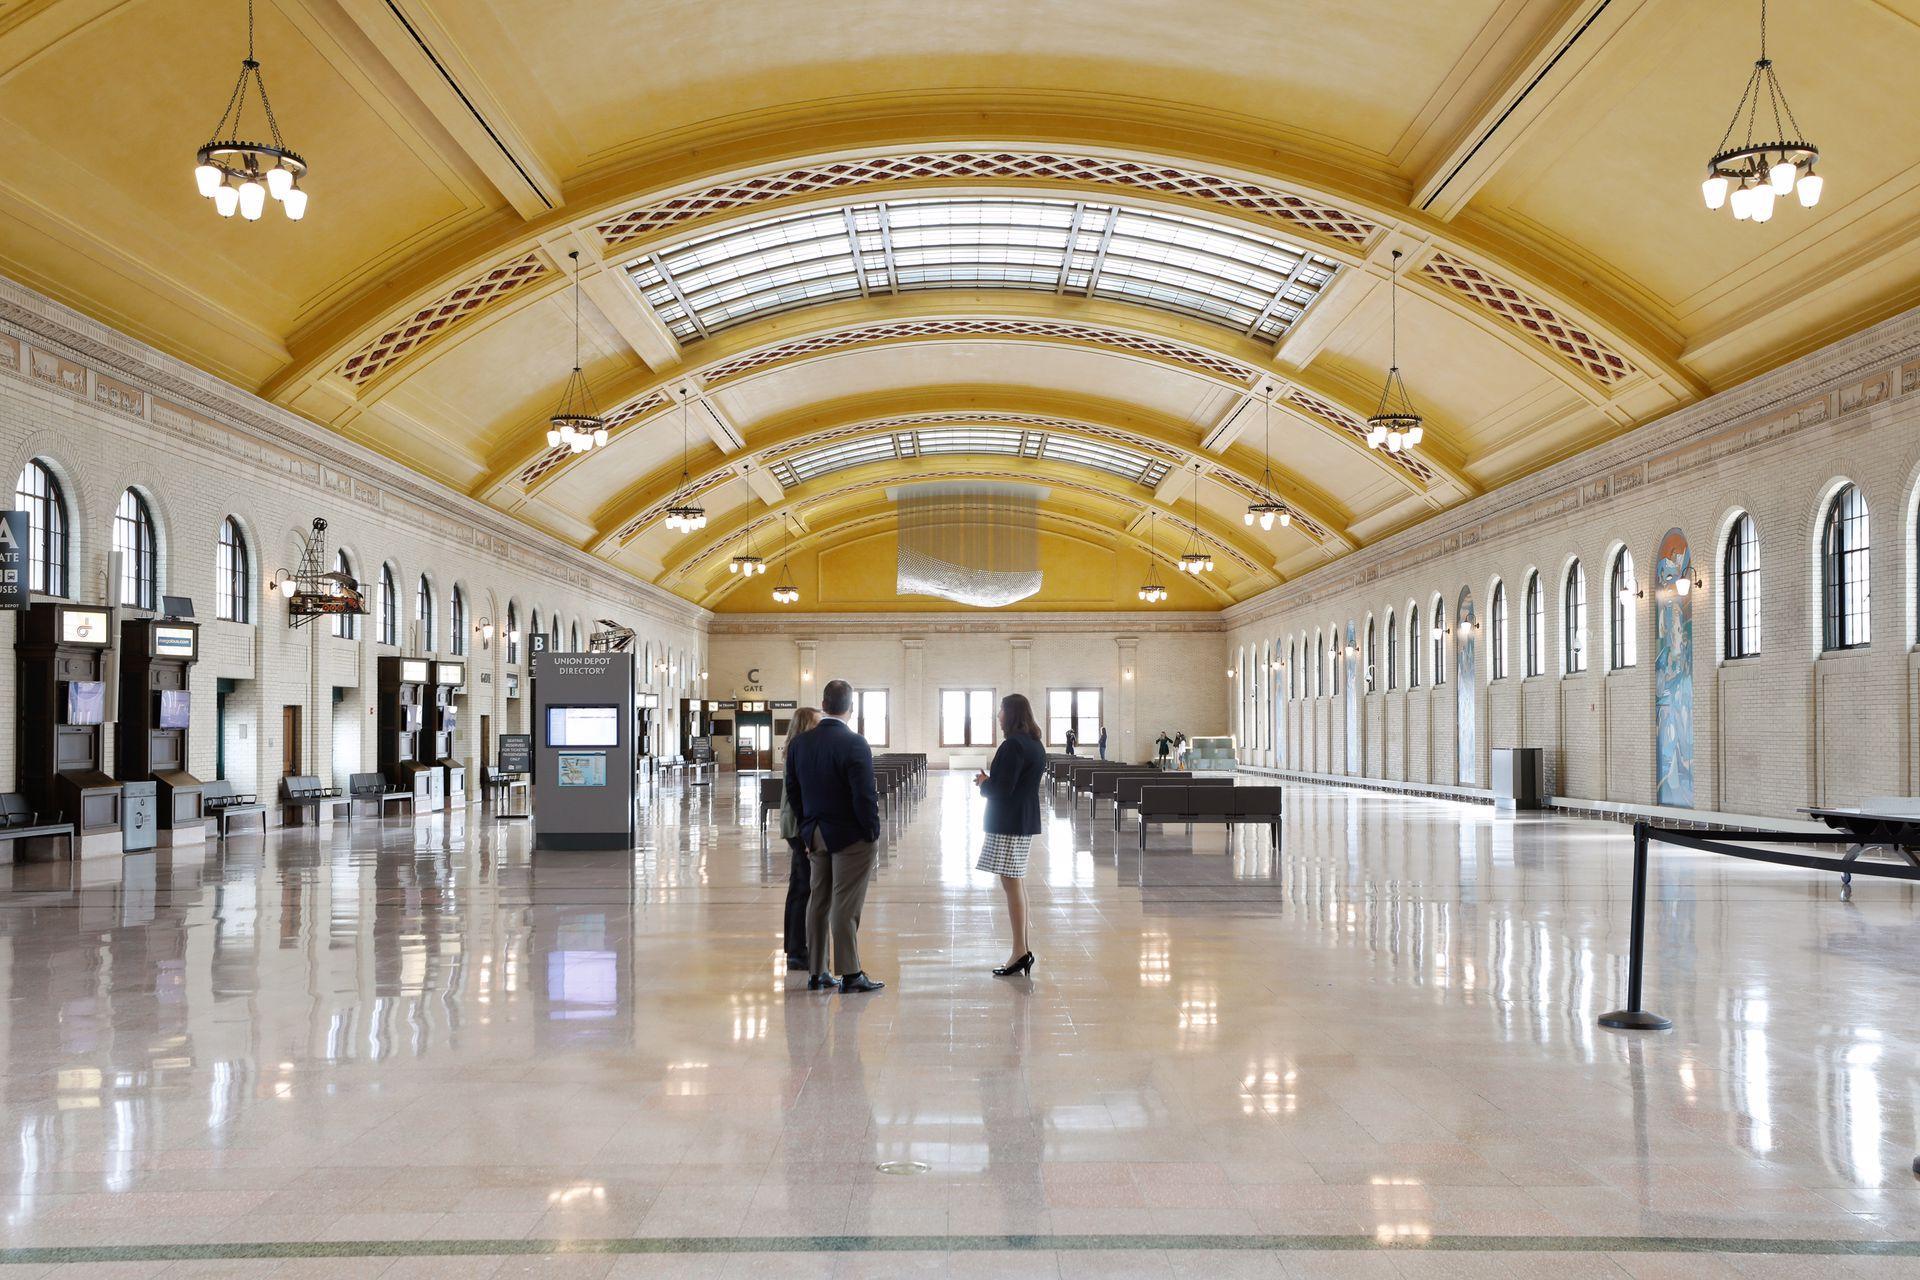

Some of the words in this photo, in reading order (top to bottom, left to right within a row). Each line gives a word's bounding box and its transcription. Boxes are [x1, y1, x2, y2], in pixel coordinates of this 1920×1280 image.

[0, 517, 19, 549] A
[534, 636, 544, 651] B
[554, 657, 582, 665] UNION
[584, 657, 612, 665] DEPOT
[559, 667, 606, 675] DIRECTORY
[747, 668, 760, 684] C
